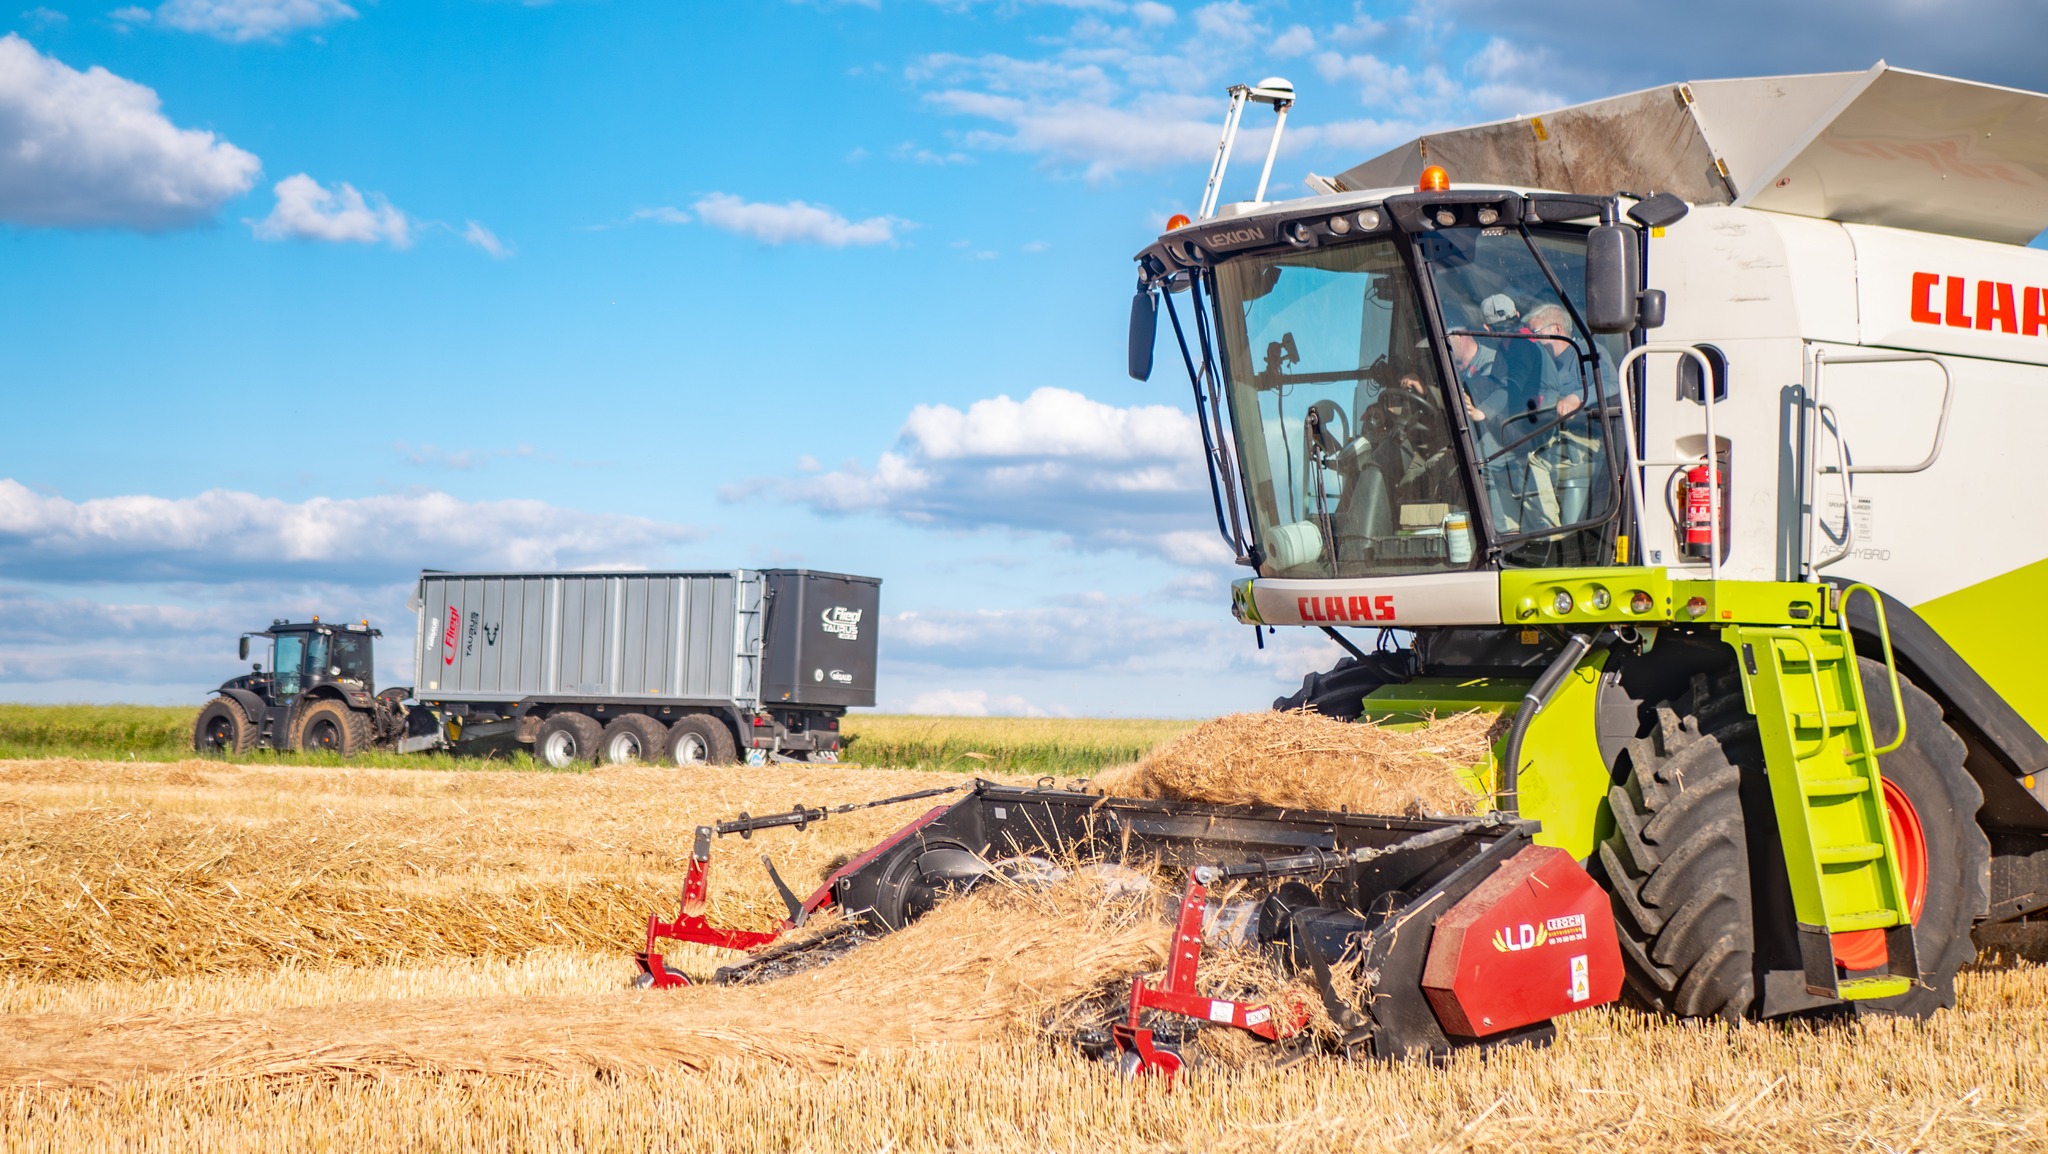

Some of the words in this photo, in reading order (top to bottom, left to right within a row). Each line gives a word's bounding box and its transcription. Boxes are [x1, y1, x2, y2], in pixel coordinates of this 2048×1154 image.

[1205, 227, 1265, 247] LEXION
[1297, 595, 1396, 622] CLAAS
[822, 623, 859, 635] TAURUS
[1505, 924, 1535, 951] LD
